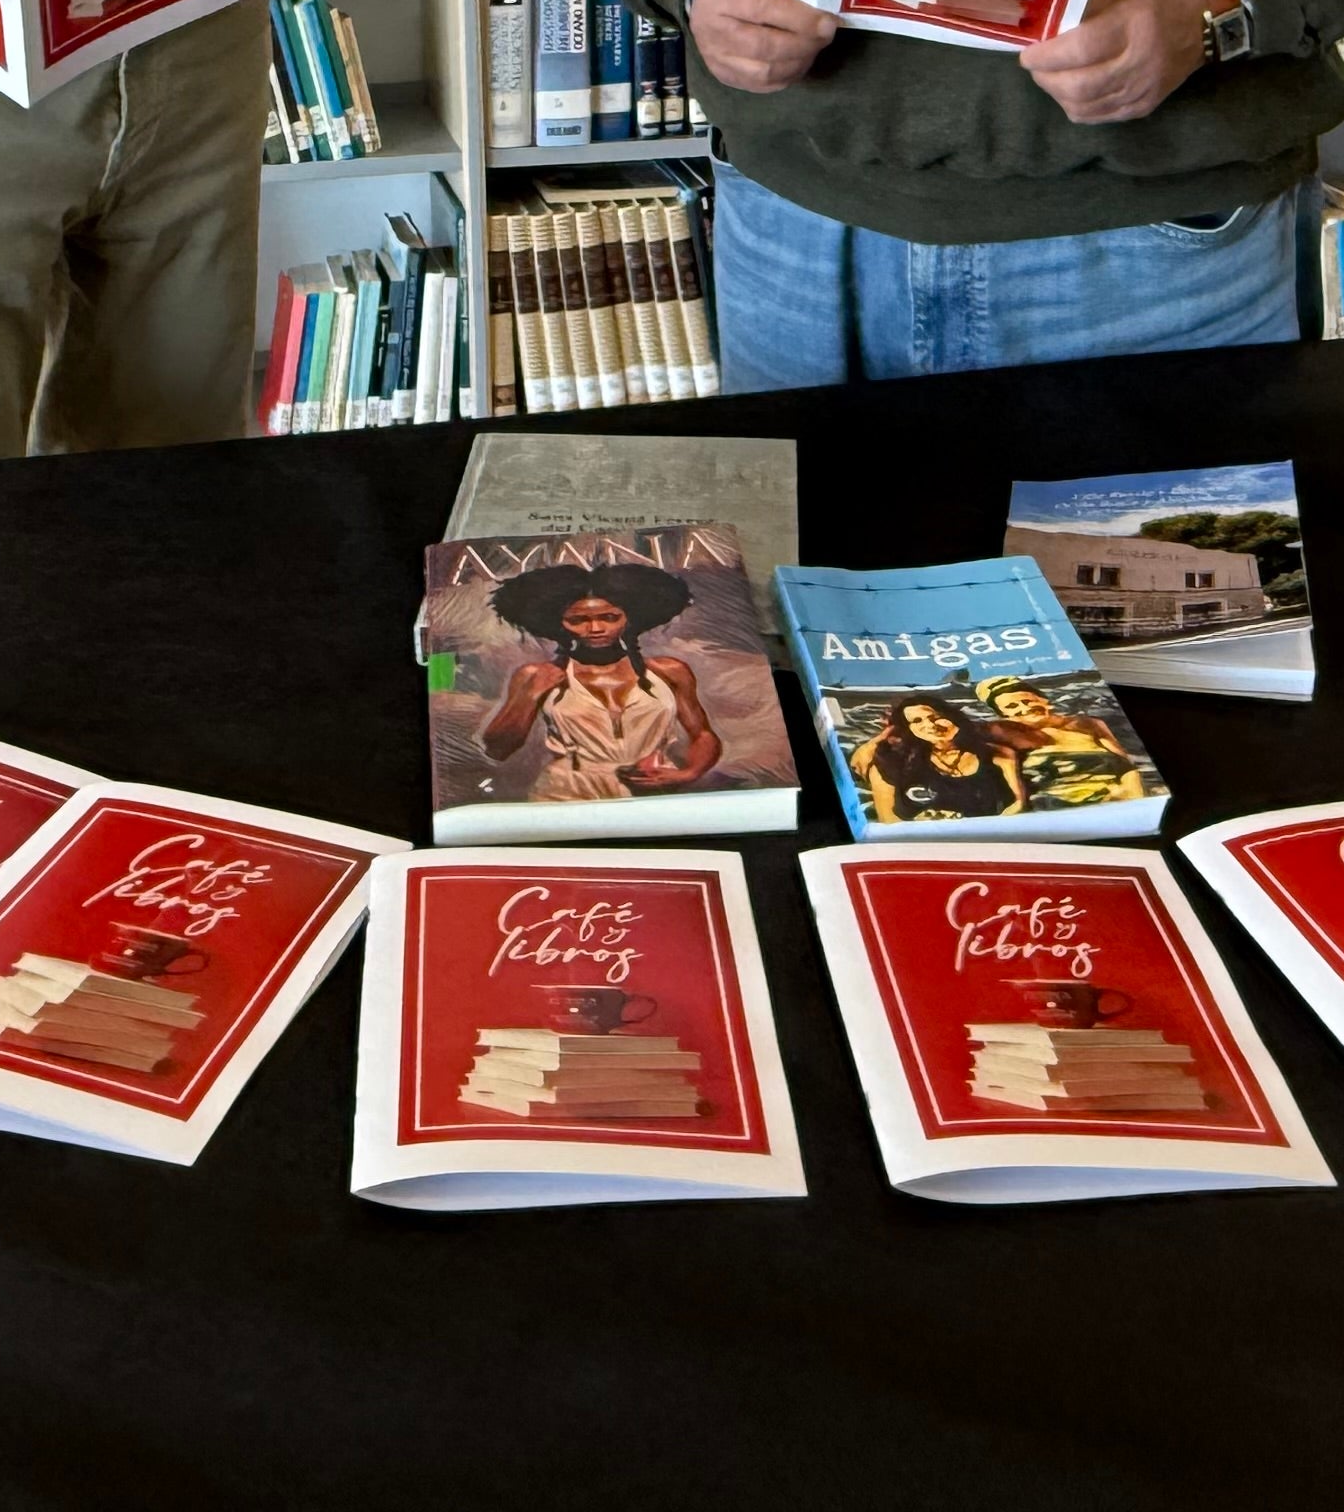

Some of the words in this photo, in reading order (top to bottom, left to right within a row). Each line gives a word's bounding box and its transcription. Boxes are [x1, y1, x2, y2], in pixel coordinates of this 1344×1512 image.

[451, 531, 739, 586] AYANA
[821, 623, 1039, 670] Amigas
[128, 833, 274, 886] Café
[81, 867, 244, 935] libros
[497, 884, 644, 936] Café
[945, 880, 1088, 937] Café
[488, 922, 645, 984] libros
[954, 921, 1102, 979] libros
